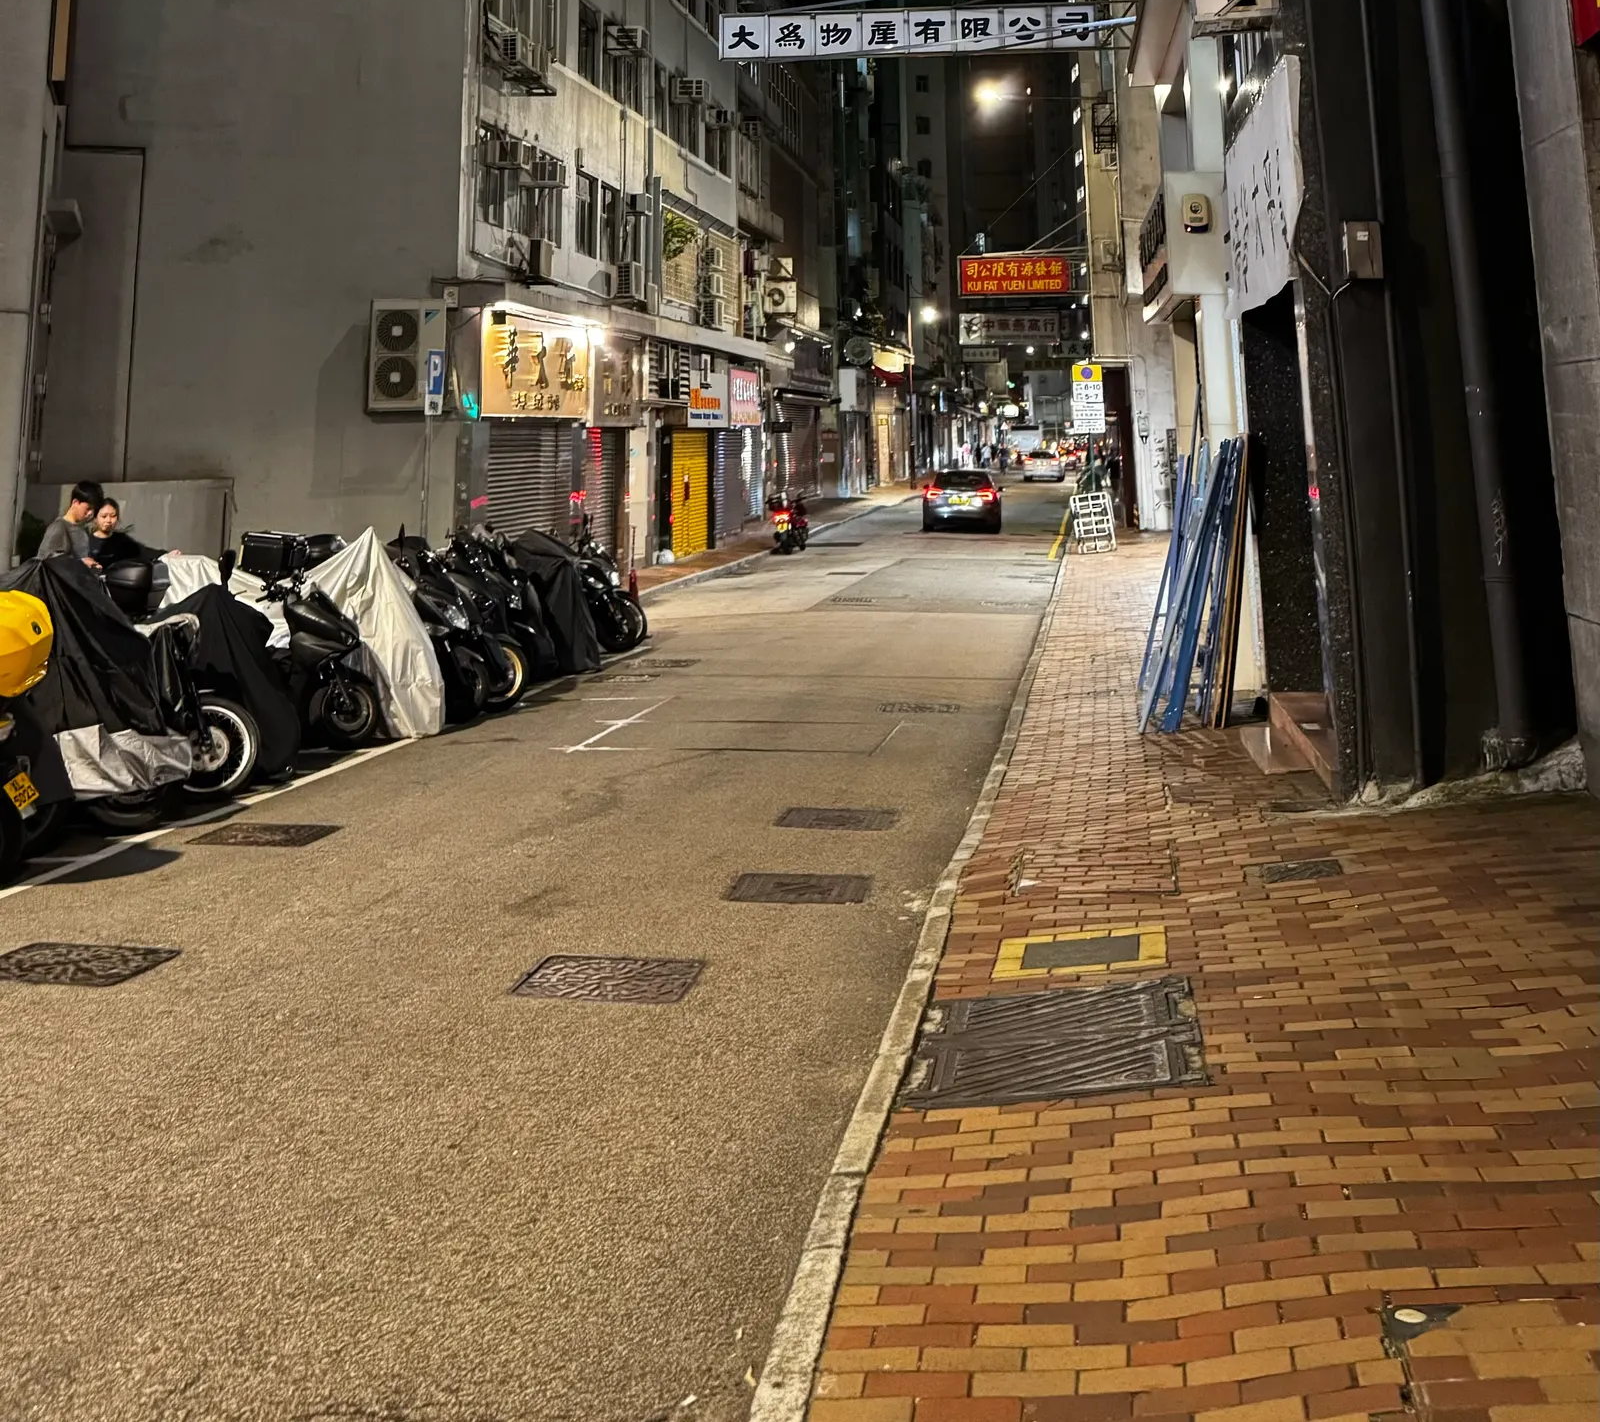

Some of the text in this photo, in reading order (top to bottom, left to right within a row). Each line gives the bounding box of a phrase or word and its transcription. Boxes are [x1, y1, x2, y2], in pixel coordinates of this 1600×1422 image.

[967, 280, 1061, 291] KUI FAT YUEN LIMITED
[429, 354, 442, 391] P
